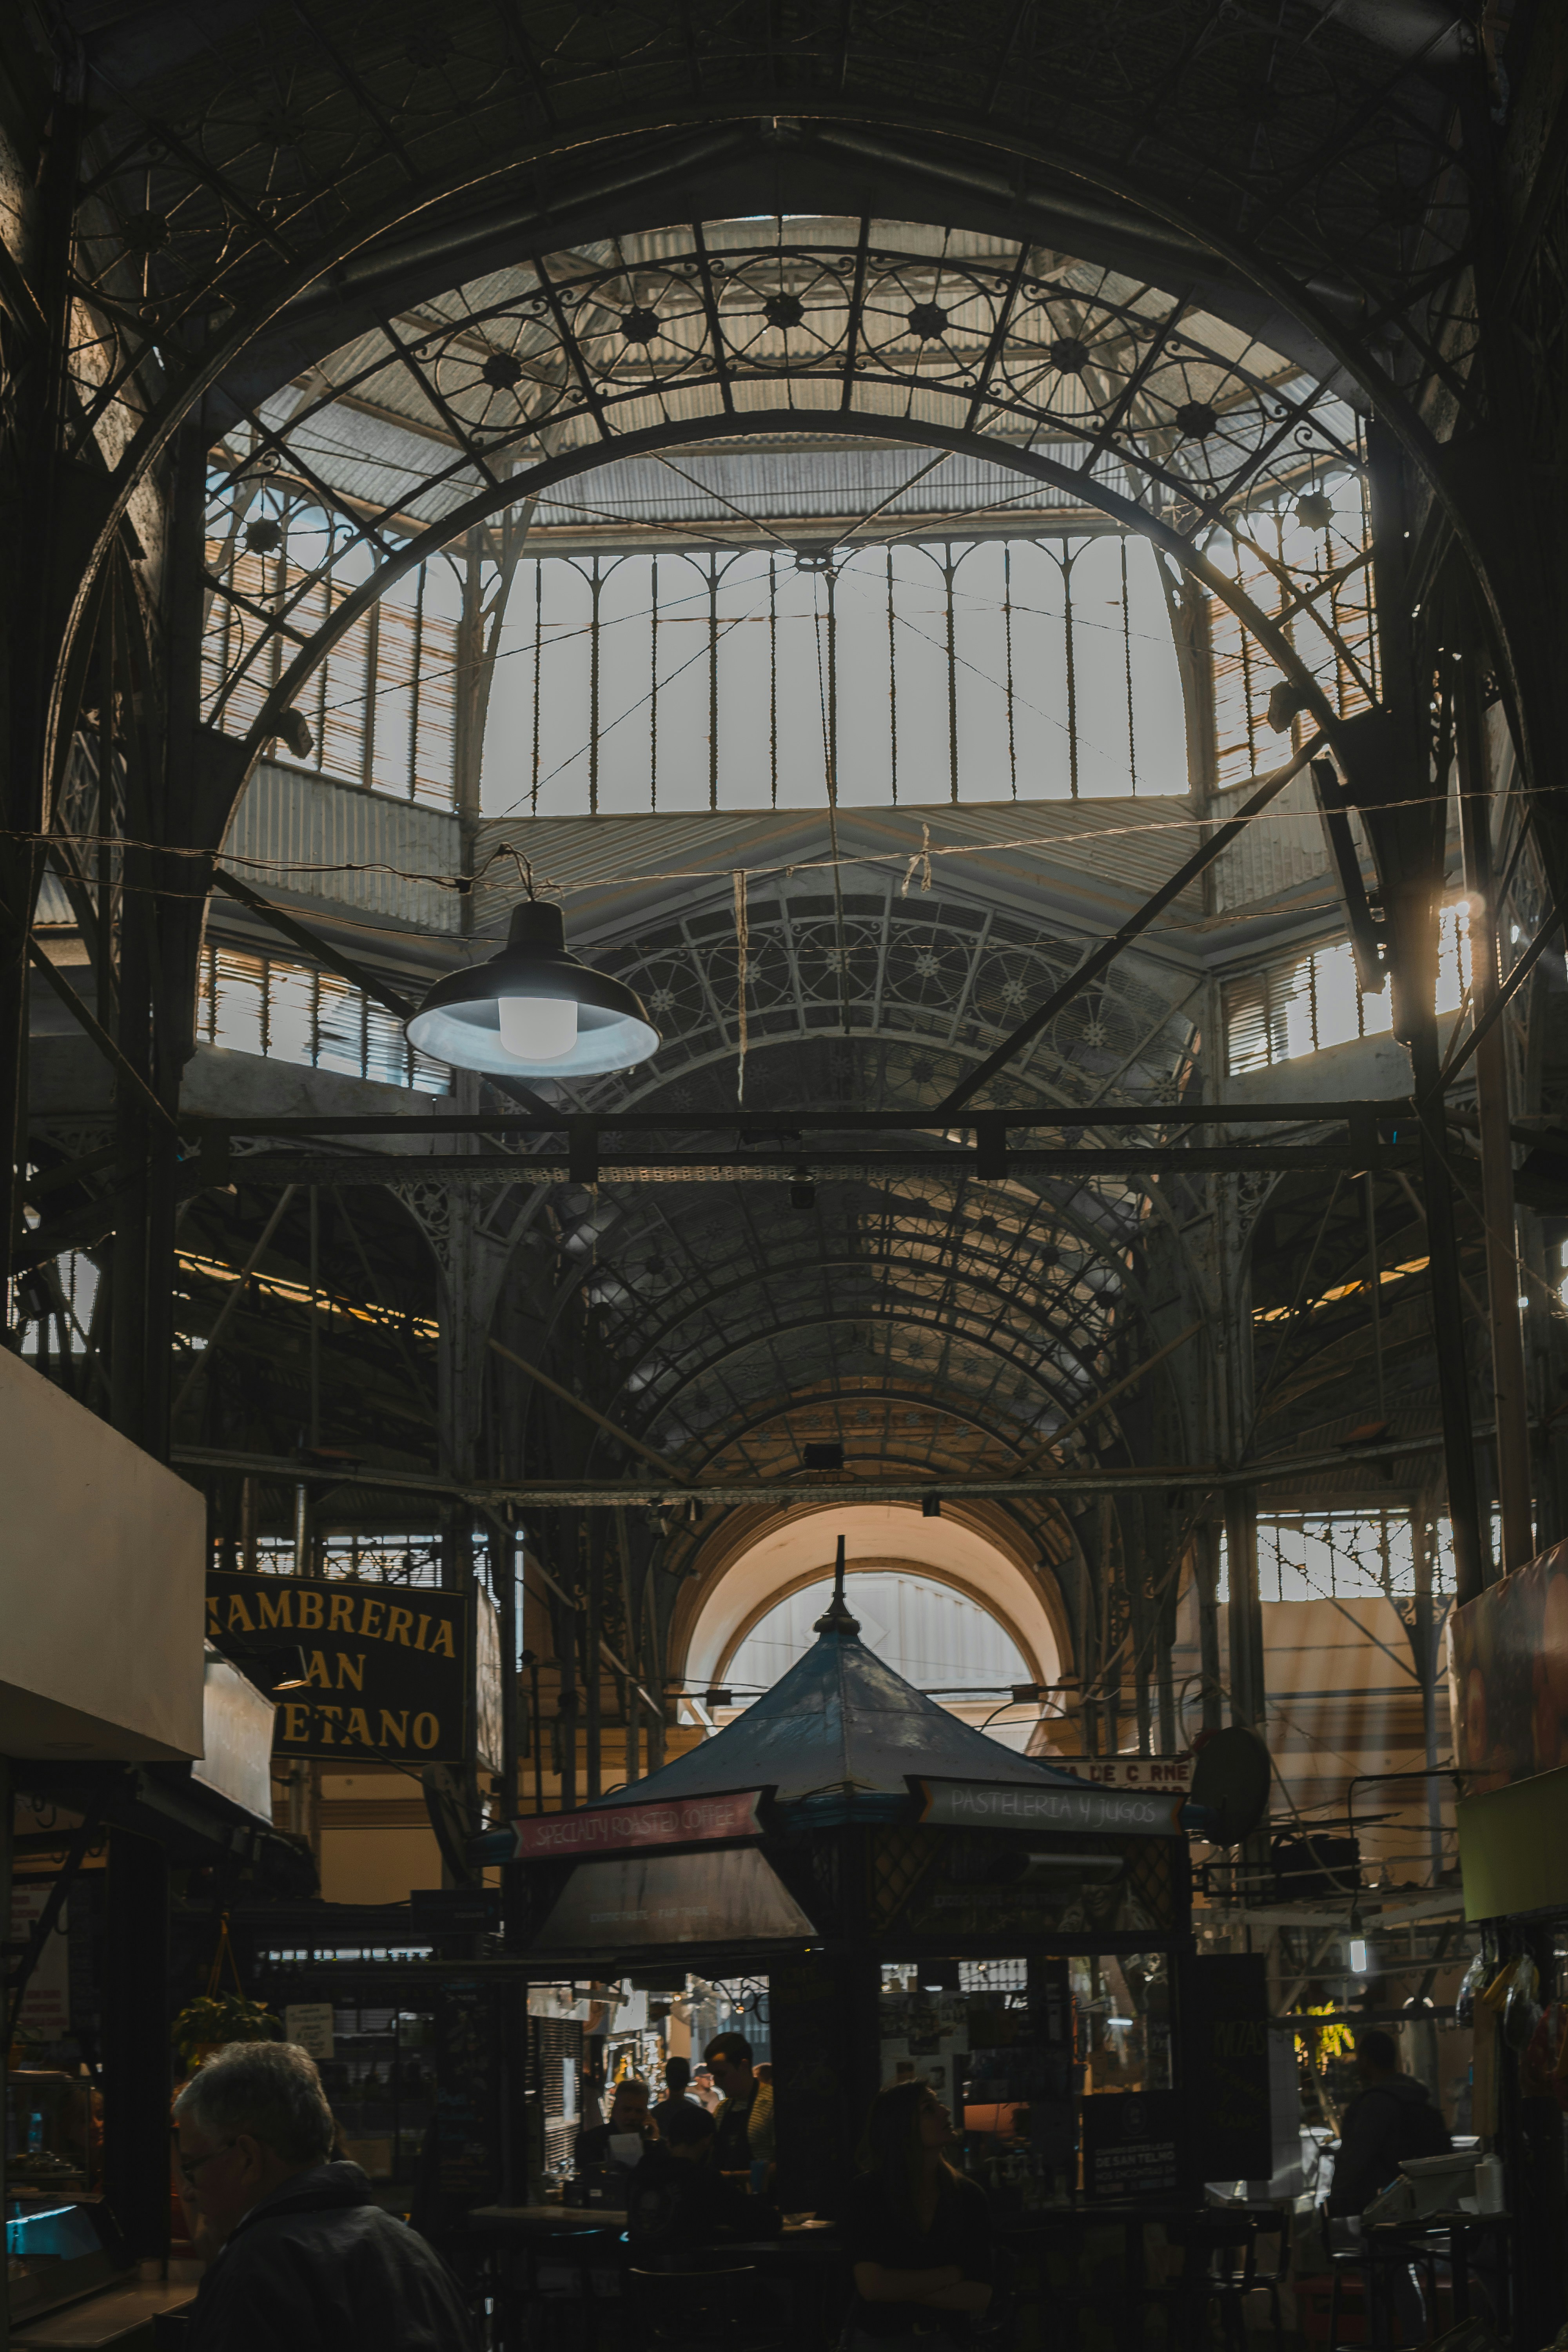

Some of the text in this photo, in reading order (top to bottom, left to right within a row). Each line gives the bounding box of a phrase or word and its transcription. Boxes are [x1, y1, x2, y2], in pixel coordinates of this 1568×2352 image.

[205, 1590, 456, 1658] IAMBRERIA
[302, 1650, 367, 1691] AN
[272, 1702, 440, 1750] ETANO
[536, 1804, 735, 1849] SPECIALTY ROASTED COFFEE
[951, 1788, 1072, 1819] PASTELERIA
[1093, 1799, 1156, 1828] JUGOS
[1096, 2151, 1176, 2168] DE SAN TELMO
